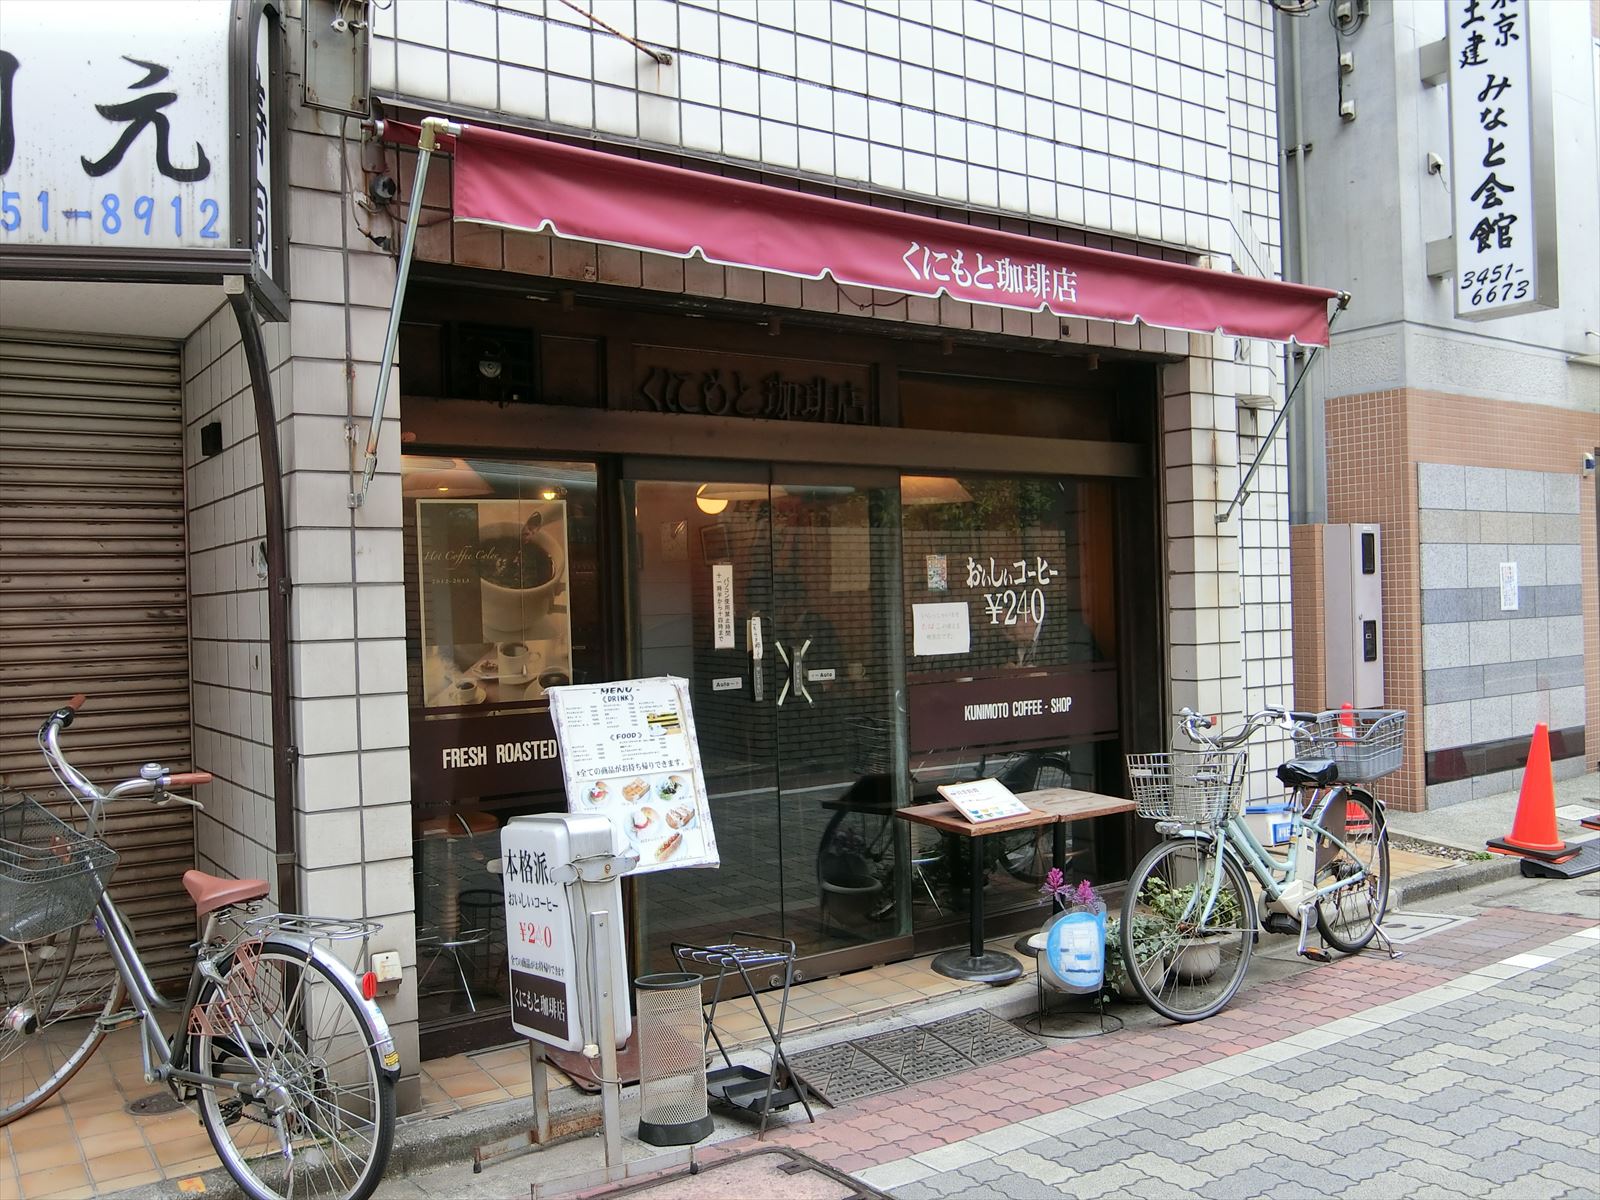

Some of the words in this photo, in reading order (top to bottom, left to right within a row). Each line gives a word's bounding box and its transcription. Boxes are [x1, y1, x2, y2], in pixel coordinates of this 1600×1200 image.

[0, 50, 212, 183] 元
[1469, 74, 1518, 254] みなと会館
[0, 190, 220, 239] 51-8912
[902, 241, 1078, 304] くにもと珈琲店
[1461, 263, 1524, 290] 3451-
[1471, 280, 1530, 306] 6673
[965, 556, 1059, 589] おいしいコーヒー
[983, 588, 1045, 626] ¥240
[600, 687, 633, 695] MENU
[964, 703, 1009, 721] KUNIMOTO
[1012, 699, 1043, 718] COFFEE
[1050, 696, 1072, 714] SHOP
[442, 745, 488, 769] FRESH
[496, 739, 558, 764] ROASTED
[508, 892, 559, 913] おいしいコーヒー
[519, 921, 552, 949] ¥20
[513, 986, 566, 1023] くにもと珈琲店
